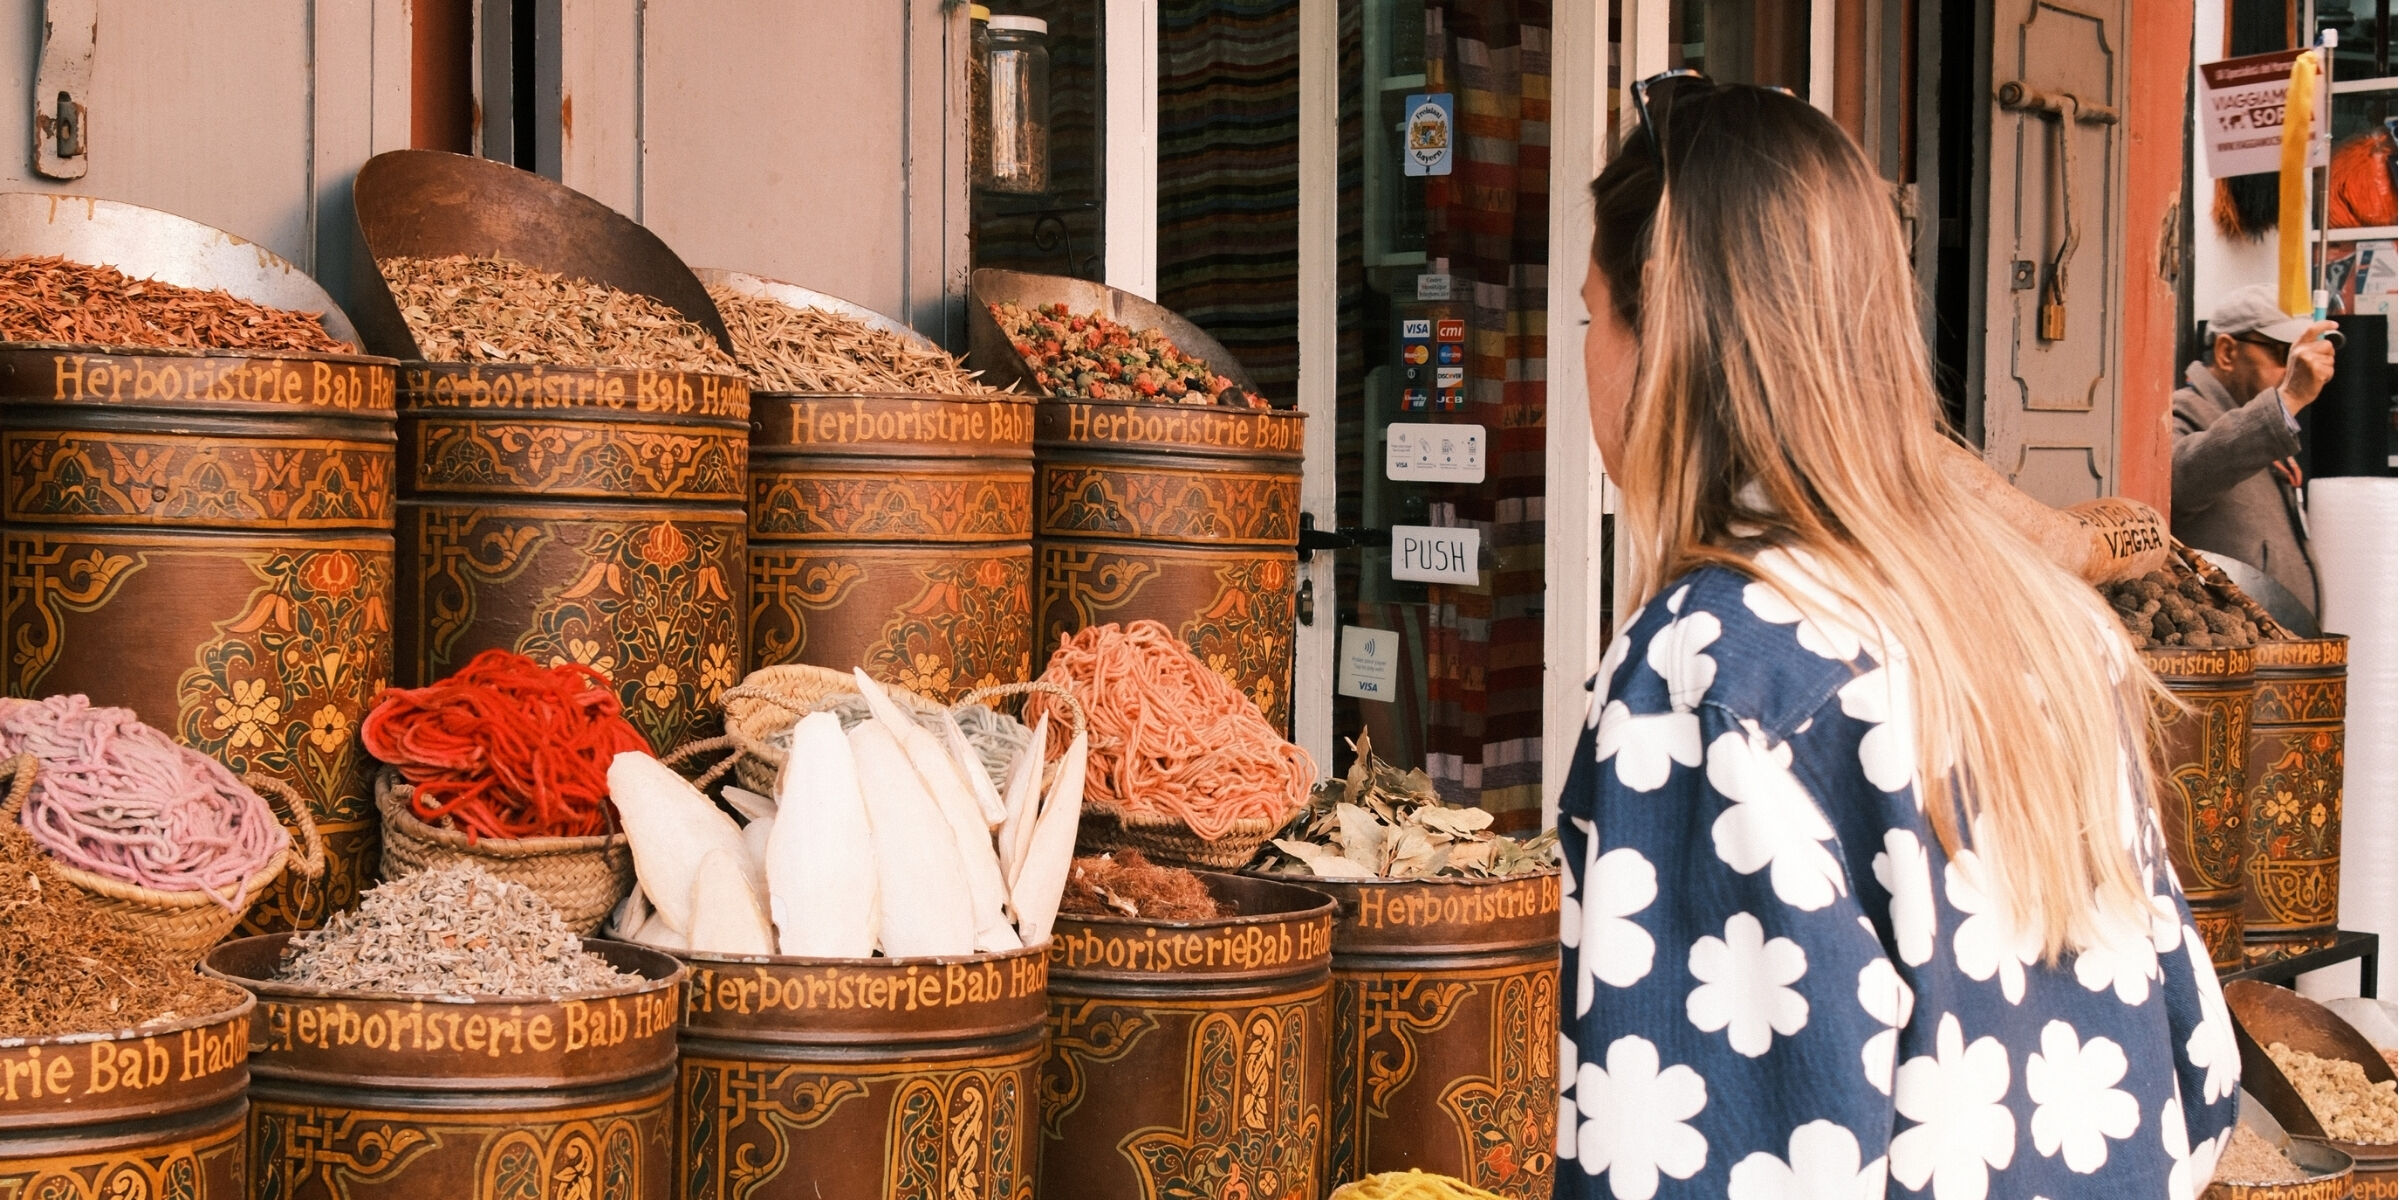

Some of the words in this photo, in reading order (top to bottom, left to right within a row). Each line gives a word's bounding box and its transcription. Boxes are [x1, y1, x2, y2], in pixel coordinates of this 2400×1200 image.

[1415, 149, 1443, 164] Bayern
[1406, 323, 1429, 335] VISA
[53, 355, 303, 404] Herboristrie
[312, 360, 363, 410] Bab
[406, 364, 627, 411] Herboristrie
[636, 368, 695, 415] Bab
[1436, 396, 1463, 404] JCB
[789, 398, 986, 445] Herboristrie
[988, 401, 1023, 444] Bab
[1067, 403, 1250, 447] Herboristrie
[1254, 413, 1290, 451] Bab
[1404, 537, 1466, 573] PUSH
[2104, 526, 2163, 560] VIAGRA
[2147, 650, 2226, 677] boristrie
[2228, 650, 2250, 677] Bab
[2255, 641, 2321, 667] oristrie
[2322, 640, 2344, 665] Bab
[1358, 681, 1378, 693] VISA
[1357, 879, 1536, 930] Herboristrie
[1539, 874, 1561, 915] Ba
[1049, 926, 1248, 973] erboristerie
[1243, 922, 1293, 970] Bab
[685, 965, 942, 1014] Herboristerie
[945, 960, 1002, 1008] Bab
[269, 1000, 556, 1057] Herboristerie
[562, 998, 629, 1054] Bab
[86, 1036, 172, 1096] Bab
